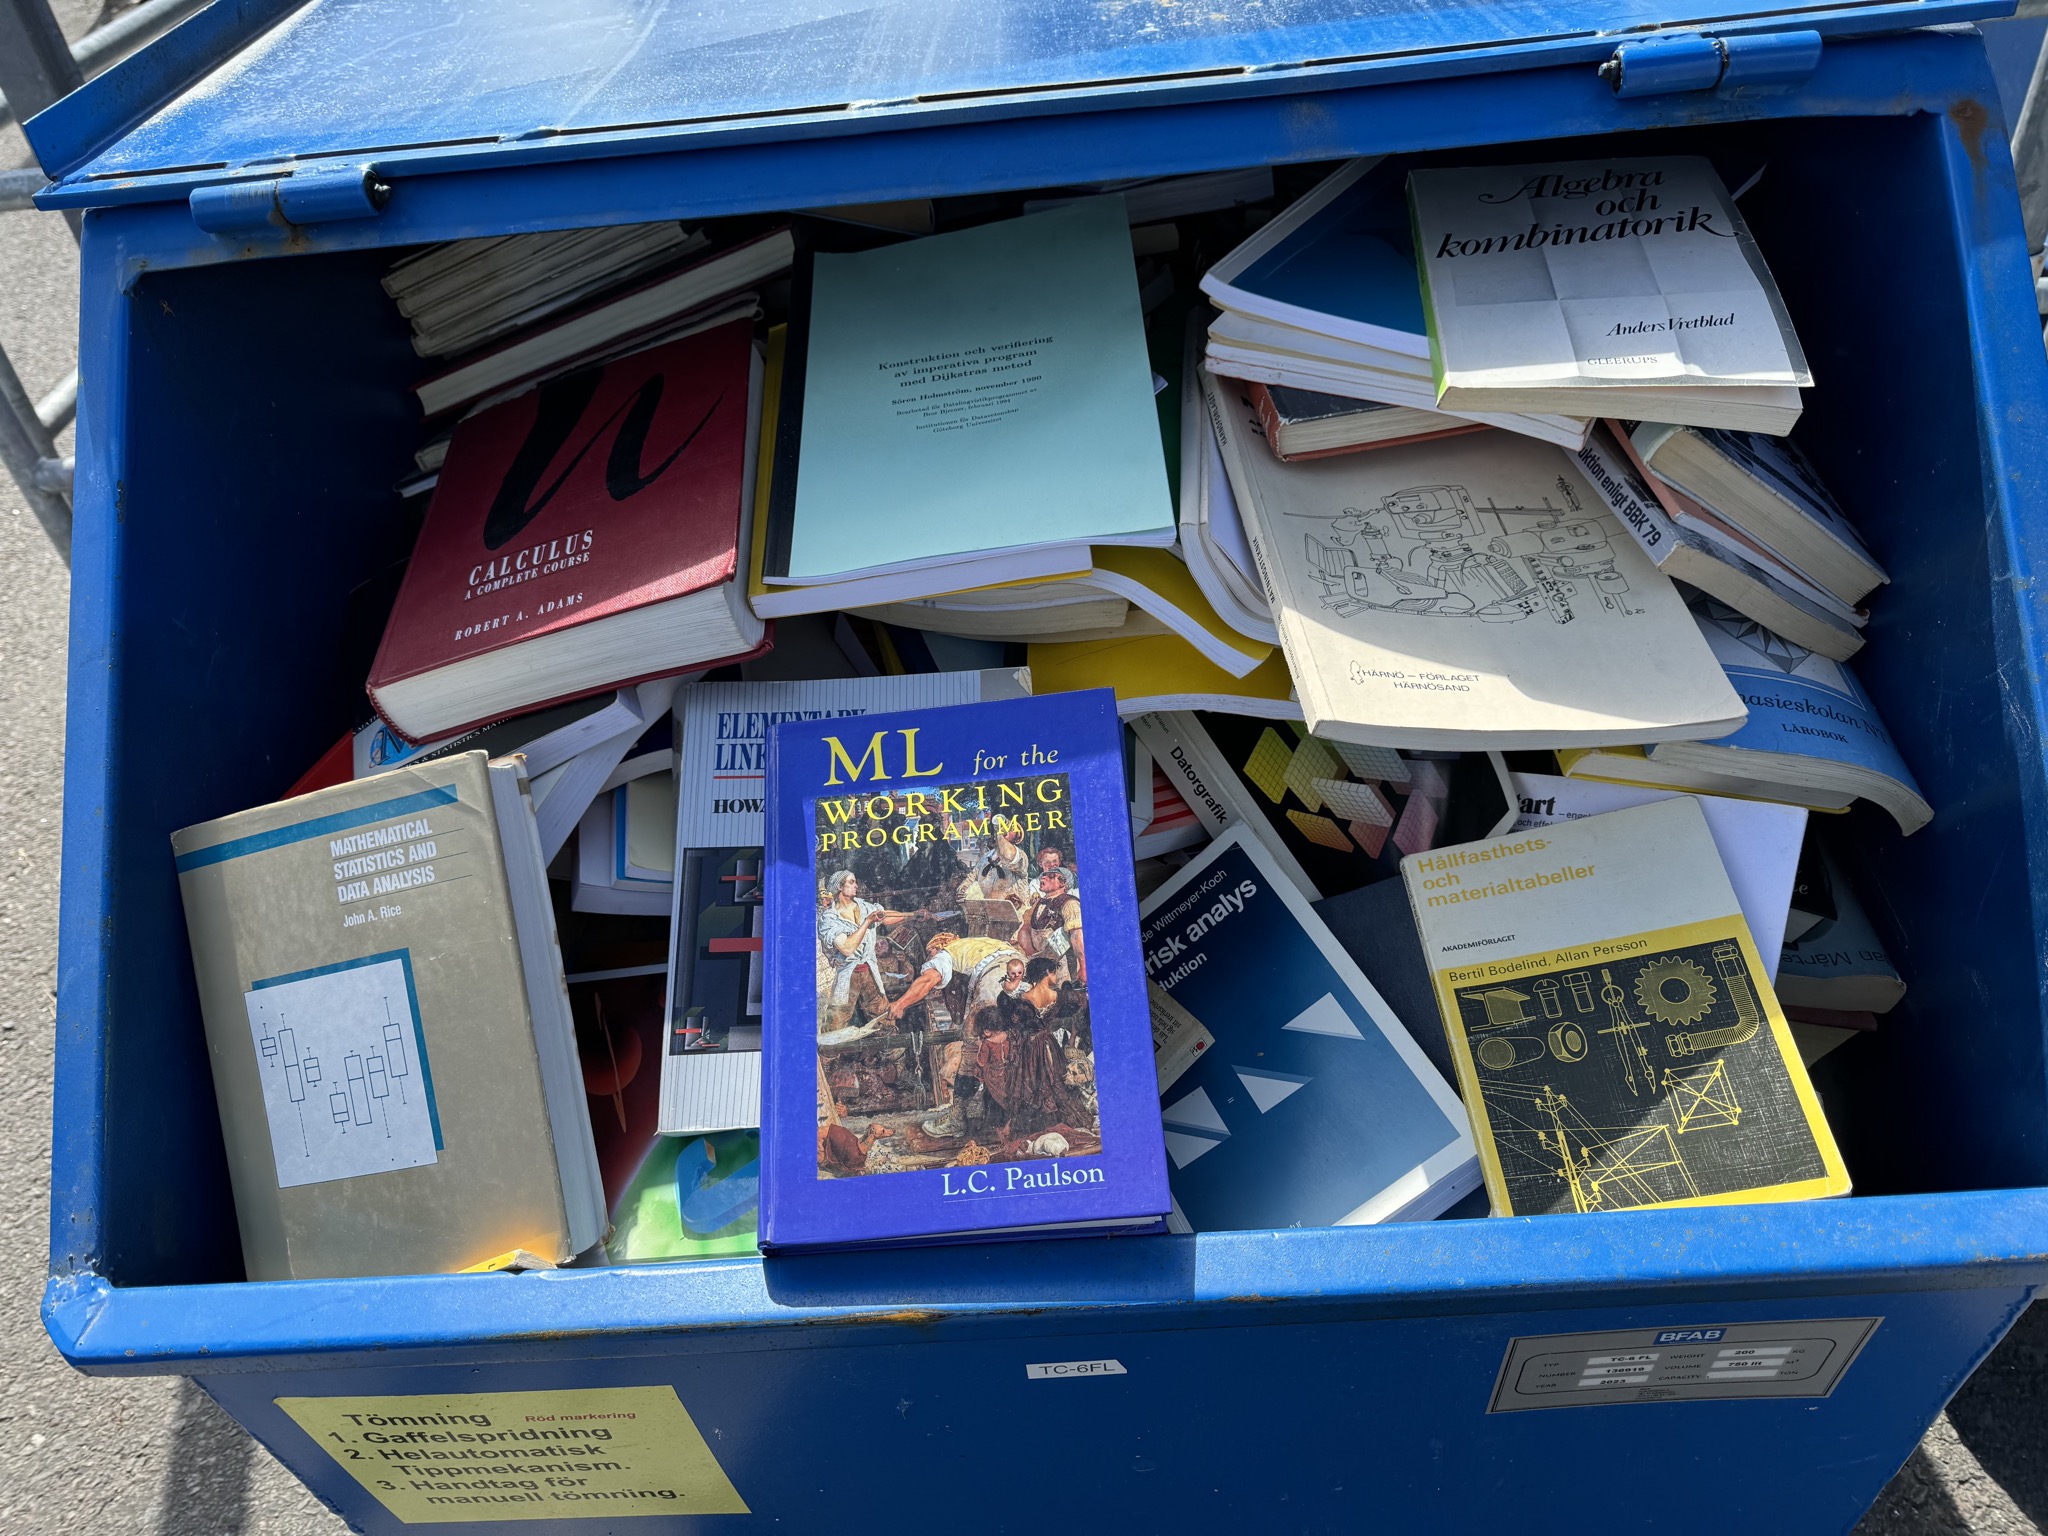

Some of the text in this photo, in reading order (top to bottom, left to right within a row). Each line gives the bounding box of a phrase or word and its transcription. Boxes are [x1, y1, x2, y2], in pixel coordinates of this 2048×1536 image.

[1477, 169, 1665, 206] Algebra
[1595, 188, 1662, 217] och
[1435, 206, 1740, 259] kombinatorik
[1605, 312, 1736, 337] Anders Vretblad
[878, 335, 1054, 371] Konstruktion och verifiering
[894, 349, 1038, 379] av imperativa program
[1587, 355, 1659, 367] GLEERUPS
[899, 359, 1033, 388] med Dijkstras metod
[891, 395, 917, 406] Sören
[920, 386, 973, 401] Holmström,
[975, 379, 1018, 392] november
[1577, 447, 1662, 547] uktion enligt BBK 79
[468, 528, 594, 587] CALCULUS
[464, 551, 591, 601] A COMPLETE COURSE
[454, 592, 585, 641] ROBERT A. ADAMS
[1361, 667, 1481, 683] HÄRNÖ FÖRLAGET
[1393, 680, 1472, 693] HÄRNÖSAND
[431, 730, 481, 757] STATISTICS
[714, 743, 766, 771] LINE
[821, 727, 1060, 787] ML for the
[1170, 745, 1228, 825] Datorgrafik
[712, 798, 766, 814] HOW
[821, 777, 1064, 826] WORKING
[330, 817, 434, 858] MATHEMATICAL
[821, 809, 1067, 853] PROGRAMMER
[333, 840, 438, 881] STATISTICS AND
[1417, 838, 1553, 875] Hållfasthets-
[337, 865, 436, 904] DATA ANALYSIS
[1422, 871, 1461, 890] och
[1427, 864, 1597, 908] materialtabeller
[1153, 868, 1228, 932] Wittmeyer-Koch
[343, 904, 403, 928] John A. Rice
[1145, 878, 1258, 976] risk analys
[1441, 934, 1516, 953] AKADEMIFÖRLAGET
[1158, 951, 1208, 992] duktion
[1449, 937, 1649, 982] Bertil Bodelind, Allan Persson
[941, 1162, 1106, 1197] L.C. Paulson
[1659, 1329, 1722, 1342] BFAB
[1039, 1362, 1116, 1376] TC-6FL
[342, 1411, 493, 1430] Tömning
[525, 1411, 637, 1423] Röd markering
[329, 1424, 614, 1446] 1. Gaffelspridning
[344, 1443, 607, 1461] 2. Helautomatisk
[377, 1474, 588, 1494] 3. Handtag för
[392, 1460, 632, 1479] Tippmekanism.
[427, 1486, 687, 1505] manuell tömning.
